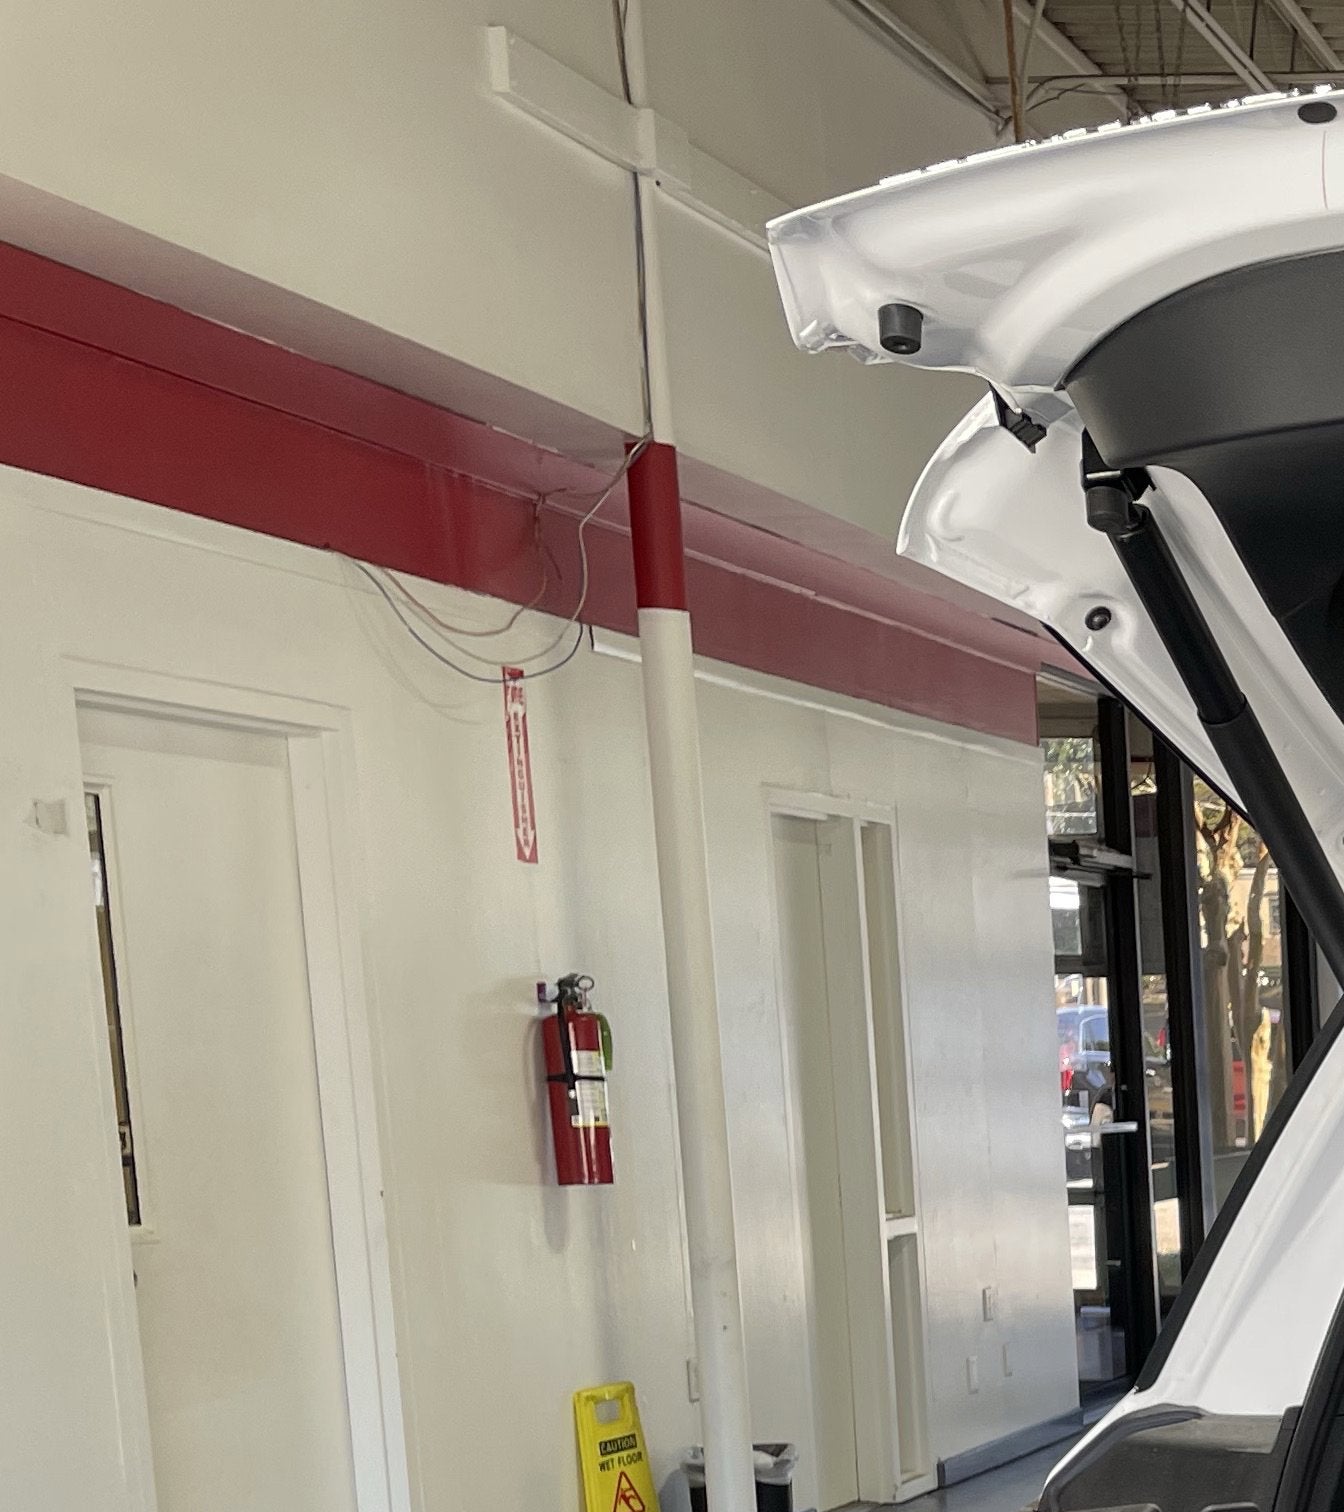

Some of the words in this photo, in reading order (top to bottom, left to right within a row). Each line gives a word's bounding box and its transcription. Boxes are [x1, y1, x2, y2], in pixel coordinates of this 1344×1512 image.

[600, 1436, 637, 1454] CAUTION
[599, 1458, 615, 1472] WET
[617, 1451, 643, 1467] FLOOR
